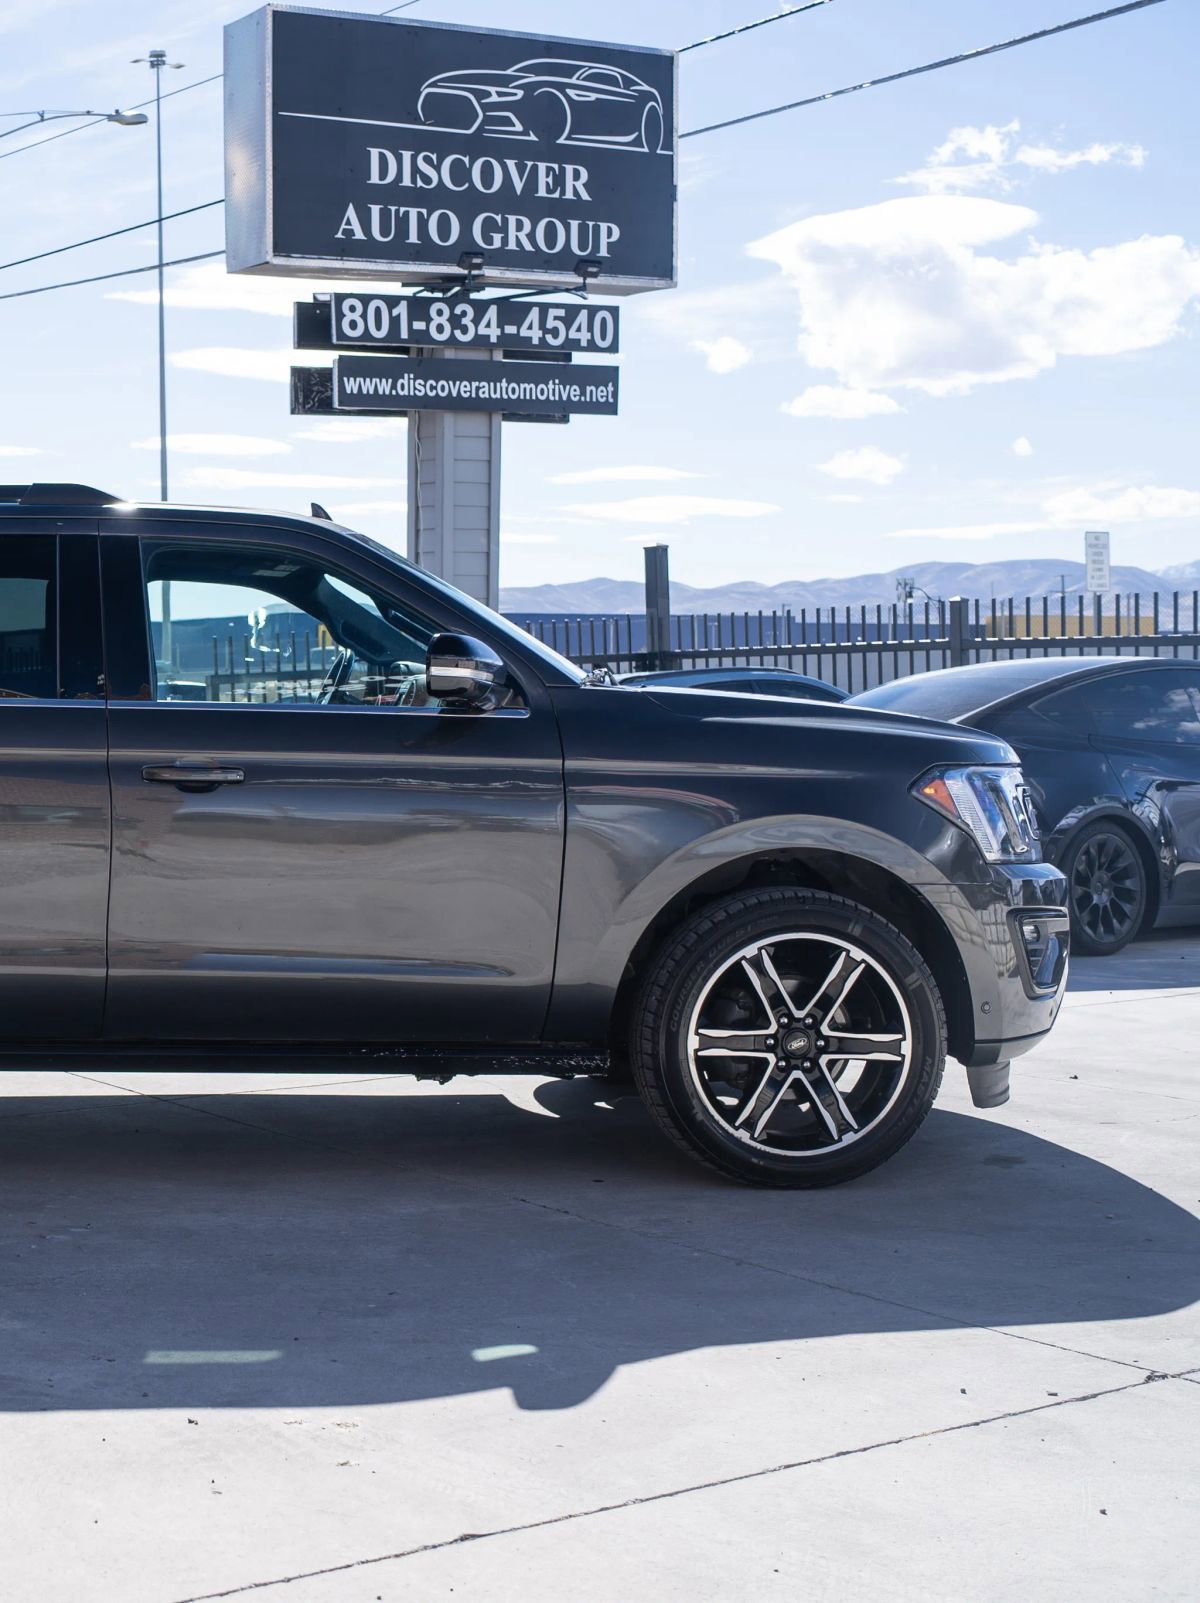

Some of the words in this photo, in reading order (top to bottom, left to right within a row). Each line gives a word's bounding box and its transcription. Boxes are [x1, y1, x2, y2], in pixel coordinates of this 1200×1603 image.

[366, 147, 593, 201] DISCOVER
[334, 202, 461, 246] AUTO
[472, 213, 621, 257] GROUP
[341, 298, 614, 348] 801-834-4540
[343, 373, 614, 403] www.discoverautomotive.net
